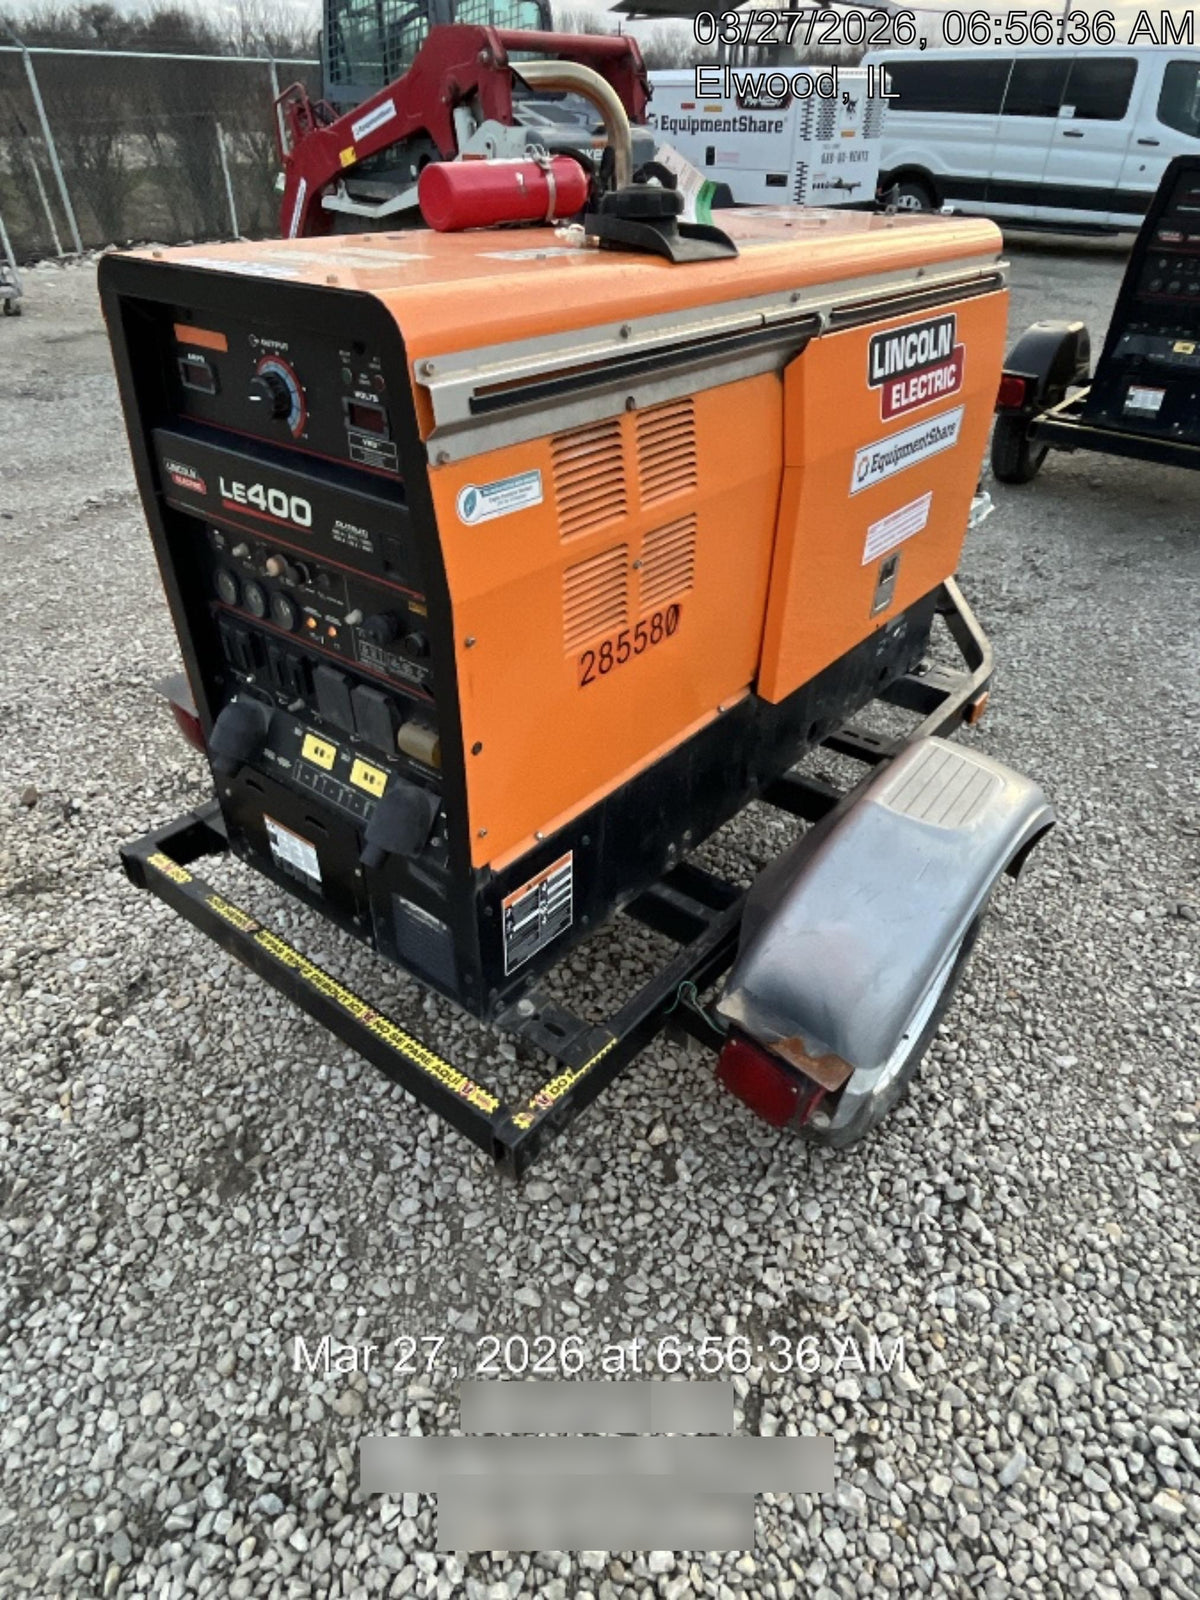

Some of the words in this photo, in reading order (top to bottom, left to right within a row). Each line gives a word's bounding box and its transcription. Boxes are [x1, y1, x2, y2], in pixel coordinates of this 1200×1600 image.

[661, 115, 784, 136] EquipmentShare
[872, 322, 953, 380] LINCOLN
[891, 363, 957, 411] ELECTRIC
[870, 422, 957, 474] EquipmentShare
[219, 476, 313, 527] LE400
[579, 603, 682, 688] 285580
[372, 1019, 391, 1034] NO
[388, 1031, 405, 1045] SE
[403, 1042, 433, 1064] PARE
